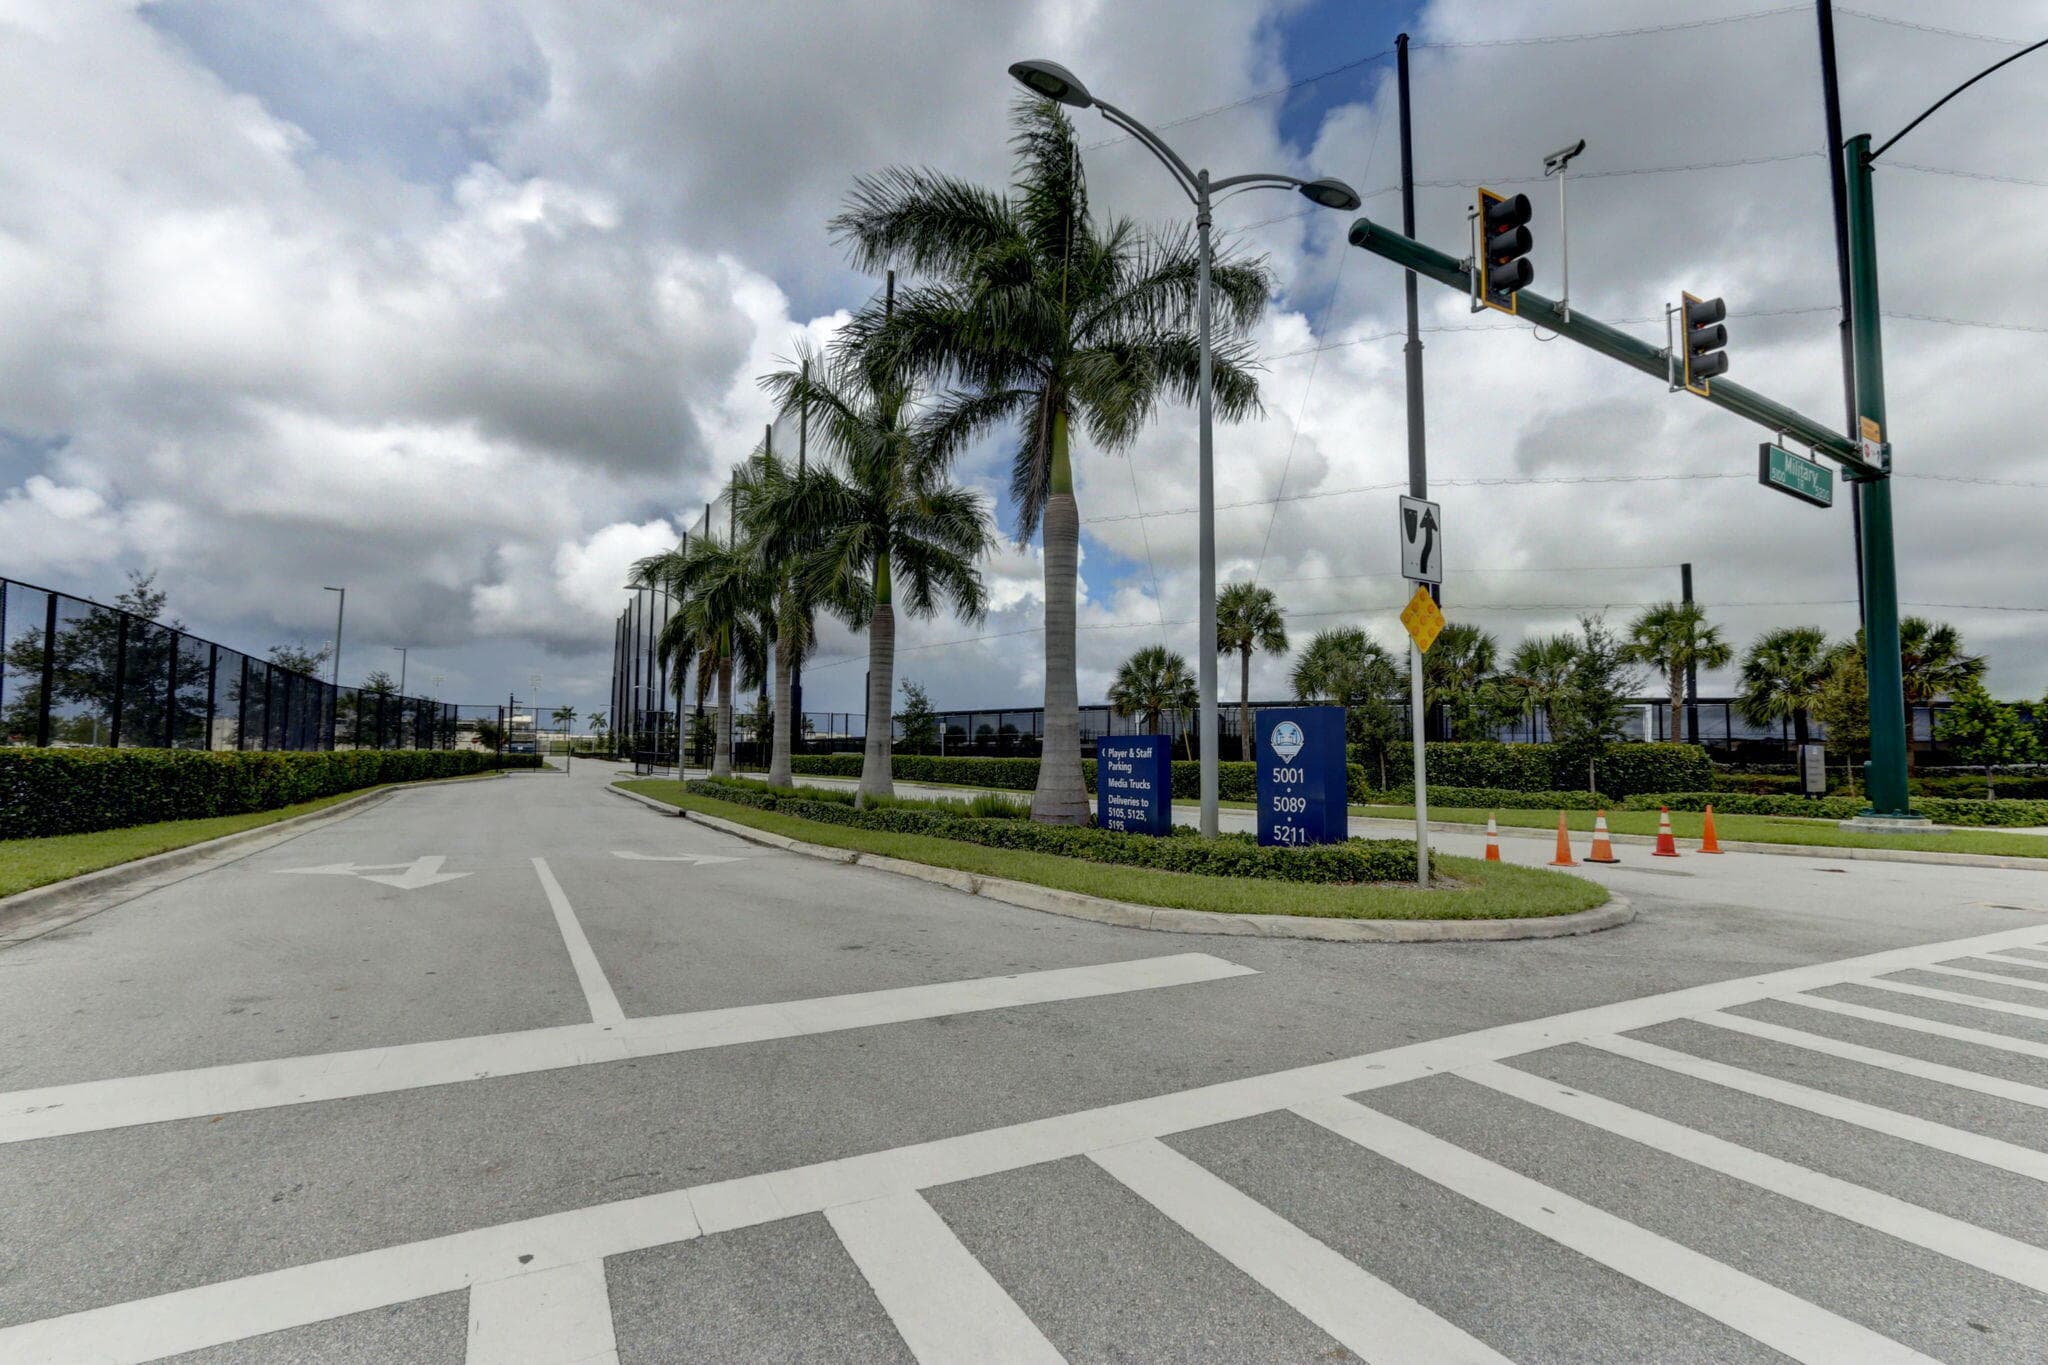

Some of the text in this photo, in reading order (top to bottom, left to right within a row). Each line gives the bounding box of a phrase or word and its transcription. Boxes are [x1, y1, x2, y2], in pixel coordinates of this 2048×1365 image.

[1785, 455, 1818, 486] Military
[1108, 747, 1152, 760] Player & Staff
[1108, 761, 1132, 773] Parking
[1272, 768, 1304, 783] 5001
[1108, 778, 1150, 789] Media Trucks
[1108, 795, 1149, 807] Deliveries to
[1273, 796, 1306, 813] 5089
[1108, 807, 1147, 821] 5105, 5125,
[1273, 825, 1305, 843] 5211
